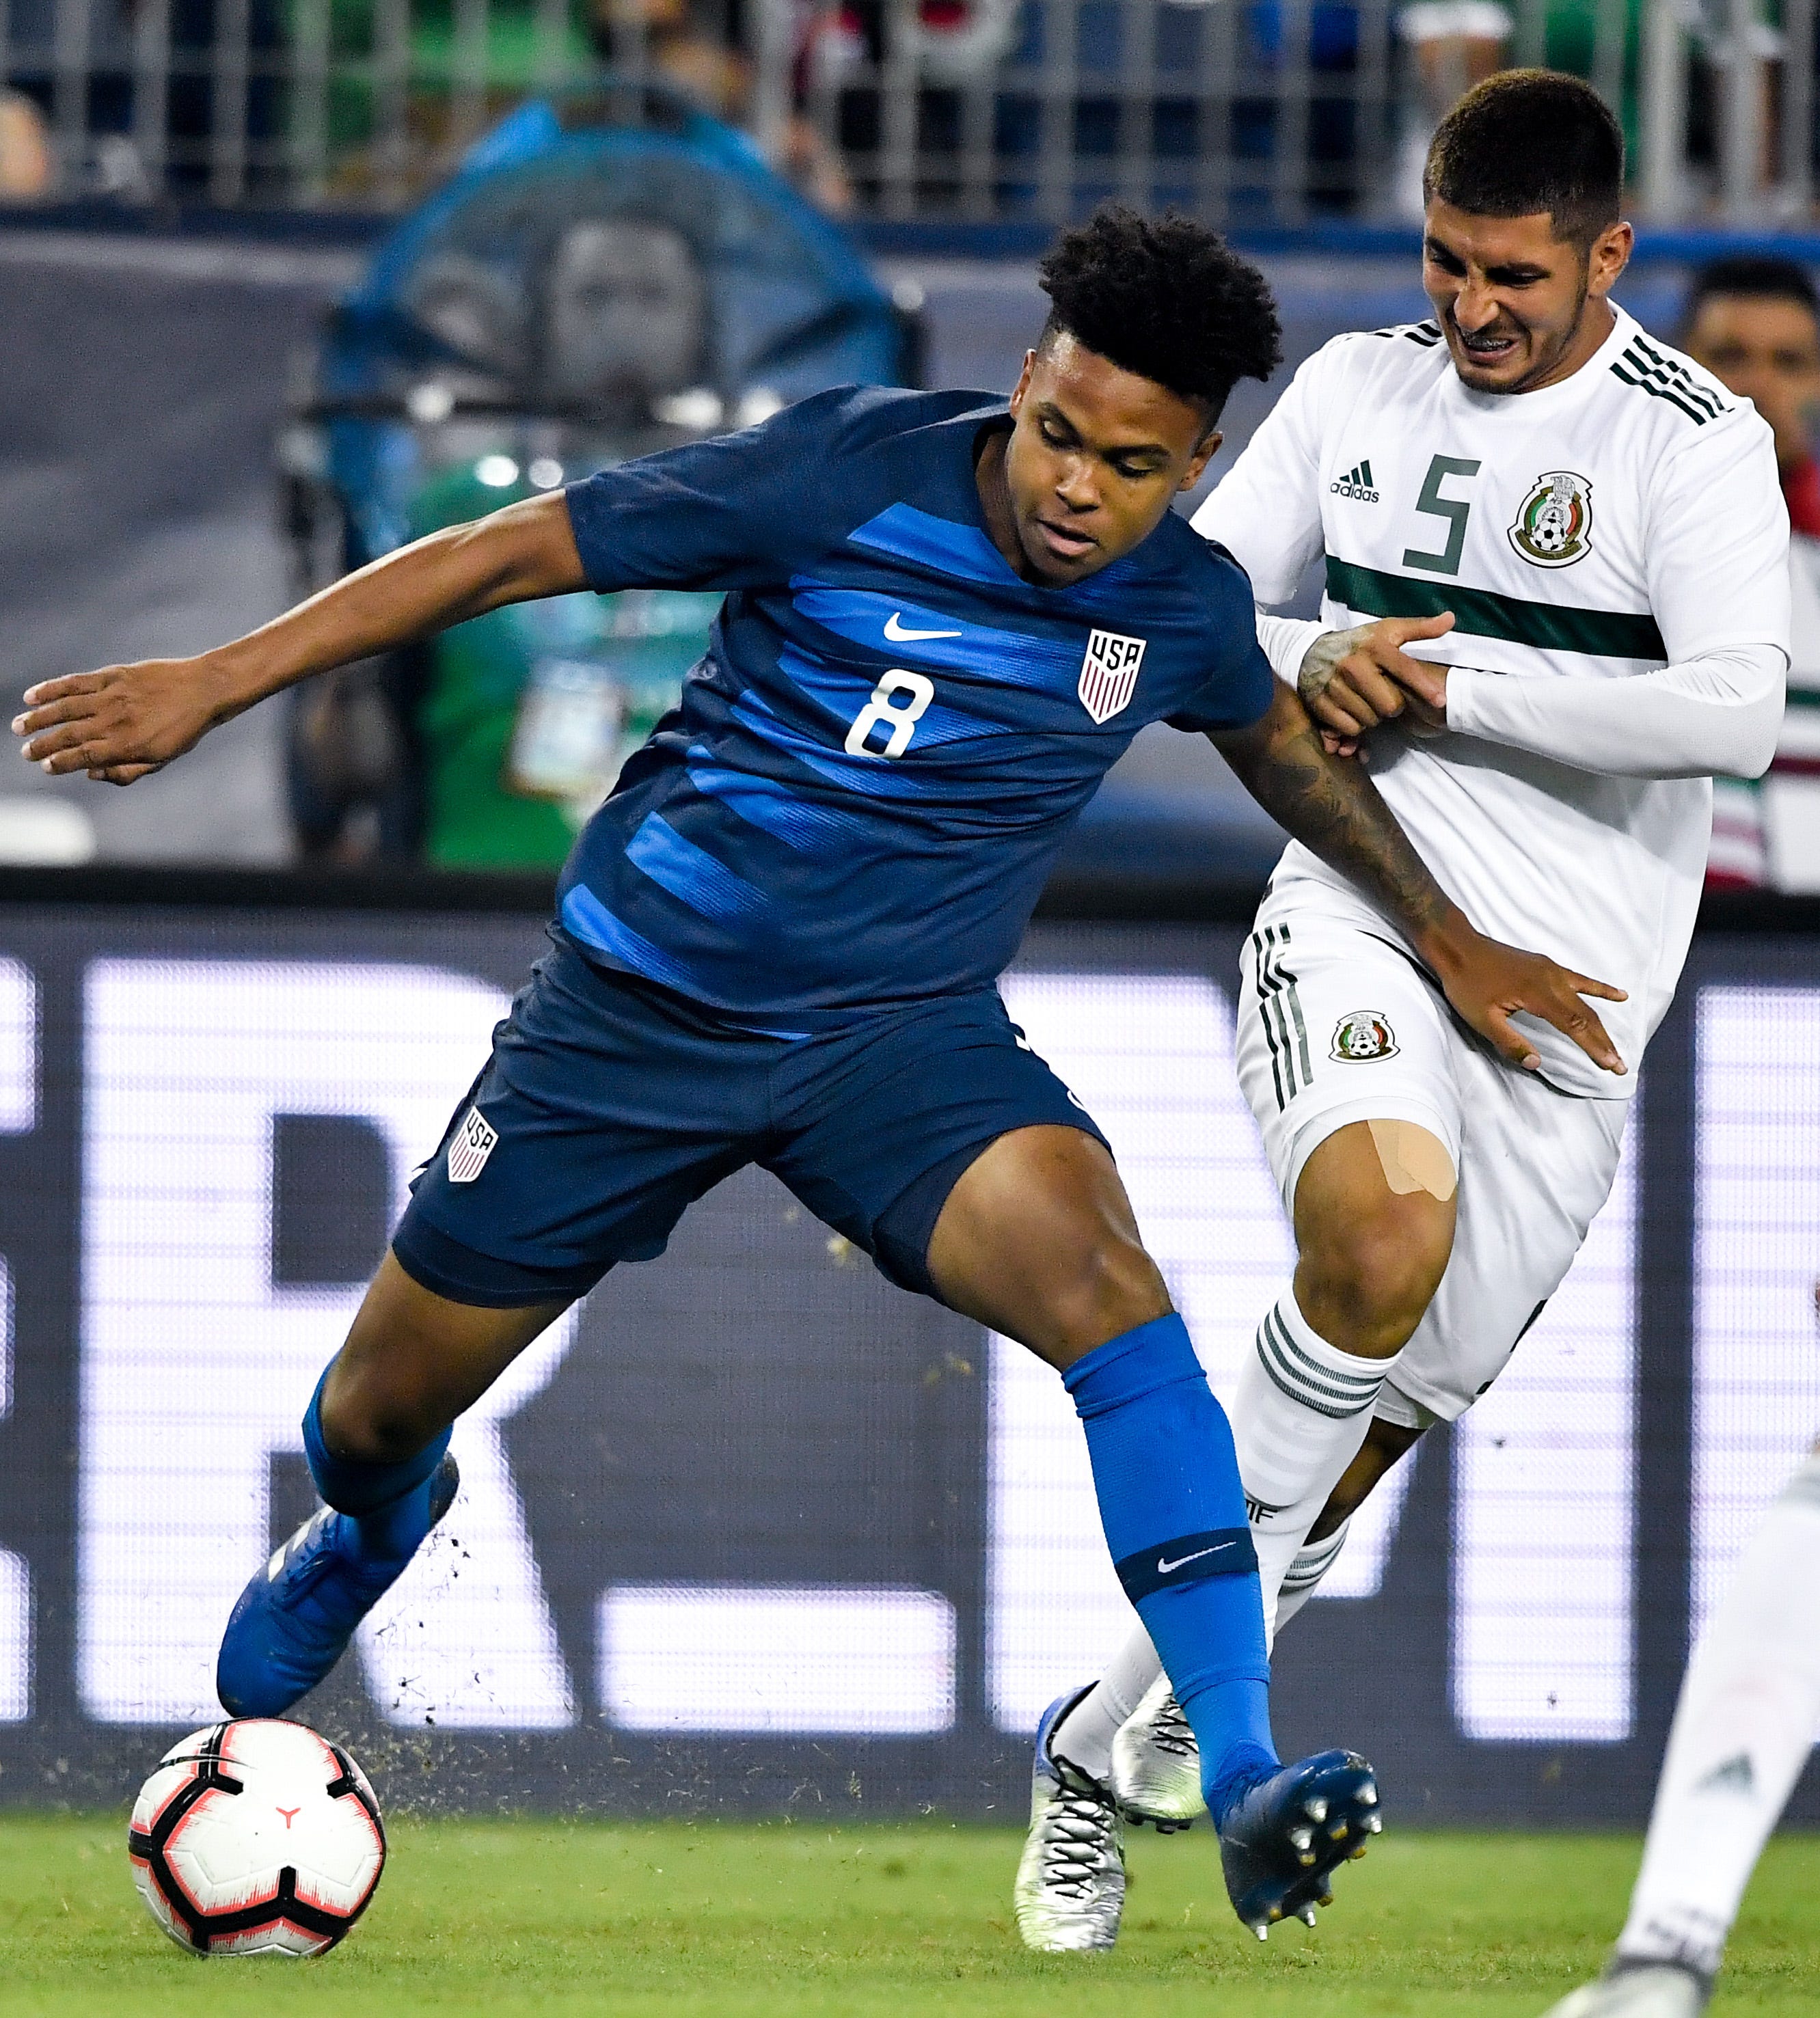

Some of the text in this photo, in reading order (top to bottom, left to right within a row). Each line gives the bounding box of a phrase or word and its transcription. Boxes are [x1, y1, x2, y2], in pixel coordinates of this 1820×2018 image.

[1330, 482, 1380, 503] adidas
[1402, 453, 1482, 576] 5
[1091, 635, 1141, 671] USA
[844, 668, 934, 759] 8
[466, 1111, 494, 1151] USA
